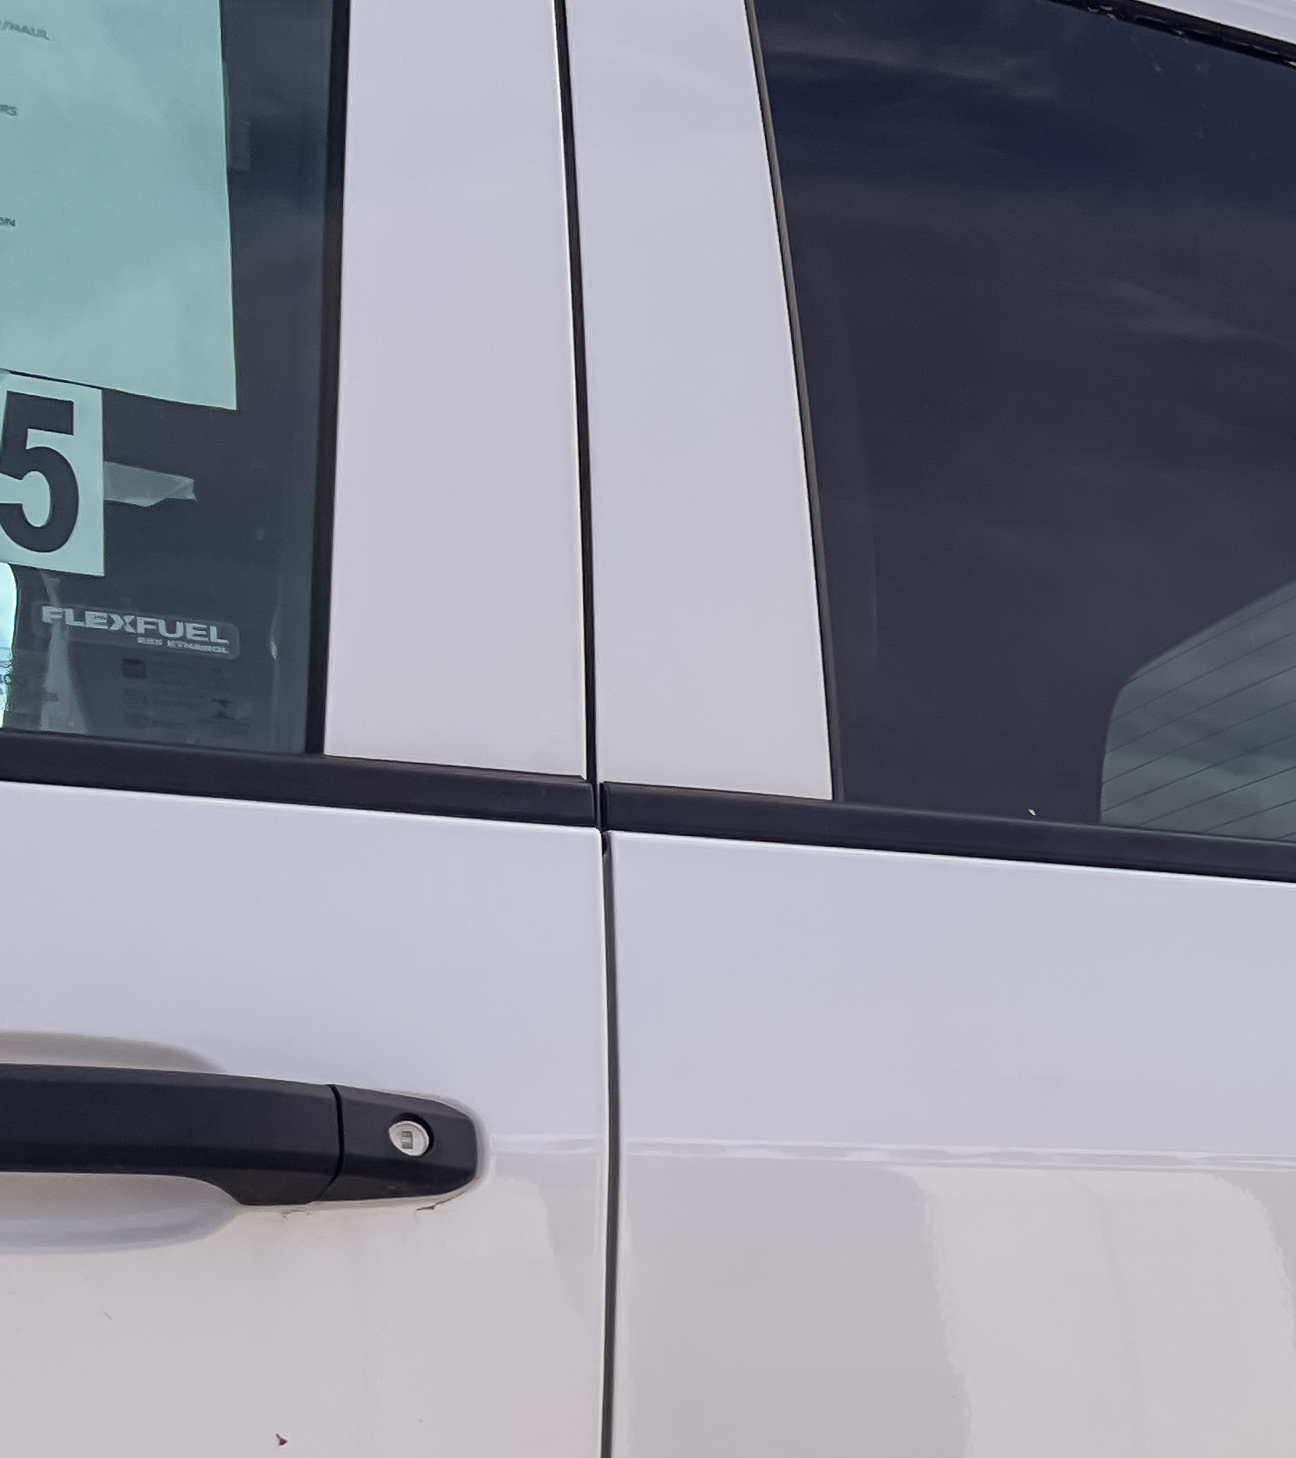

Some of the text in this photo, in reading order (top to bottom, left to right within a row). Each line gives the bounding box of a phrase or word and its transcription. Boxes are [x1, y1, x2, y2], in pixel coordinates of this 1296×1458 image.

[0, 18, 49, 41] /HAUL
[0, 390, 79, 553] 5
[41, 604, 230, 645] FLEXFUEL
